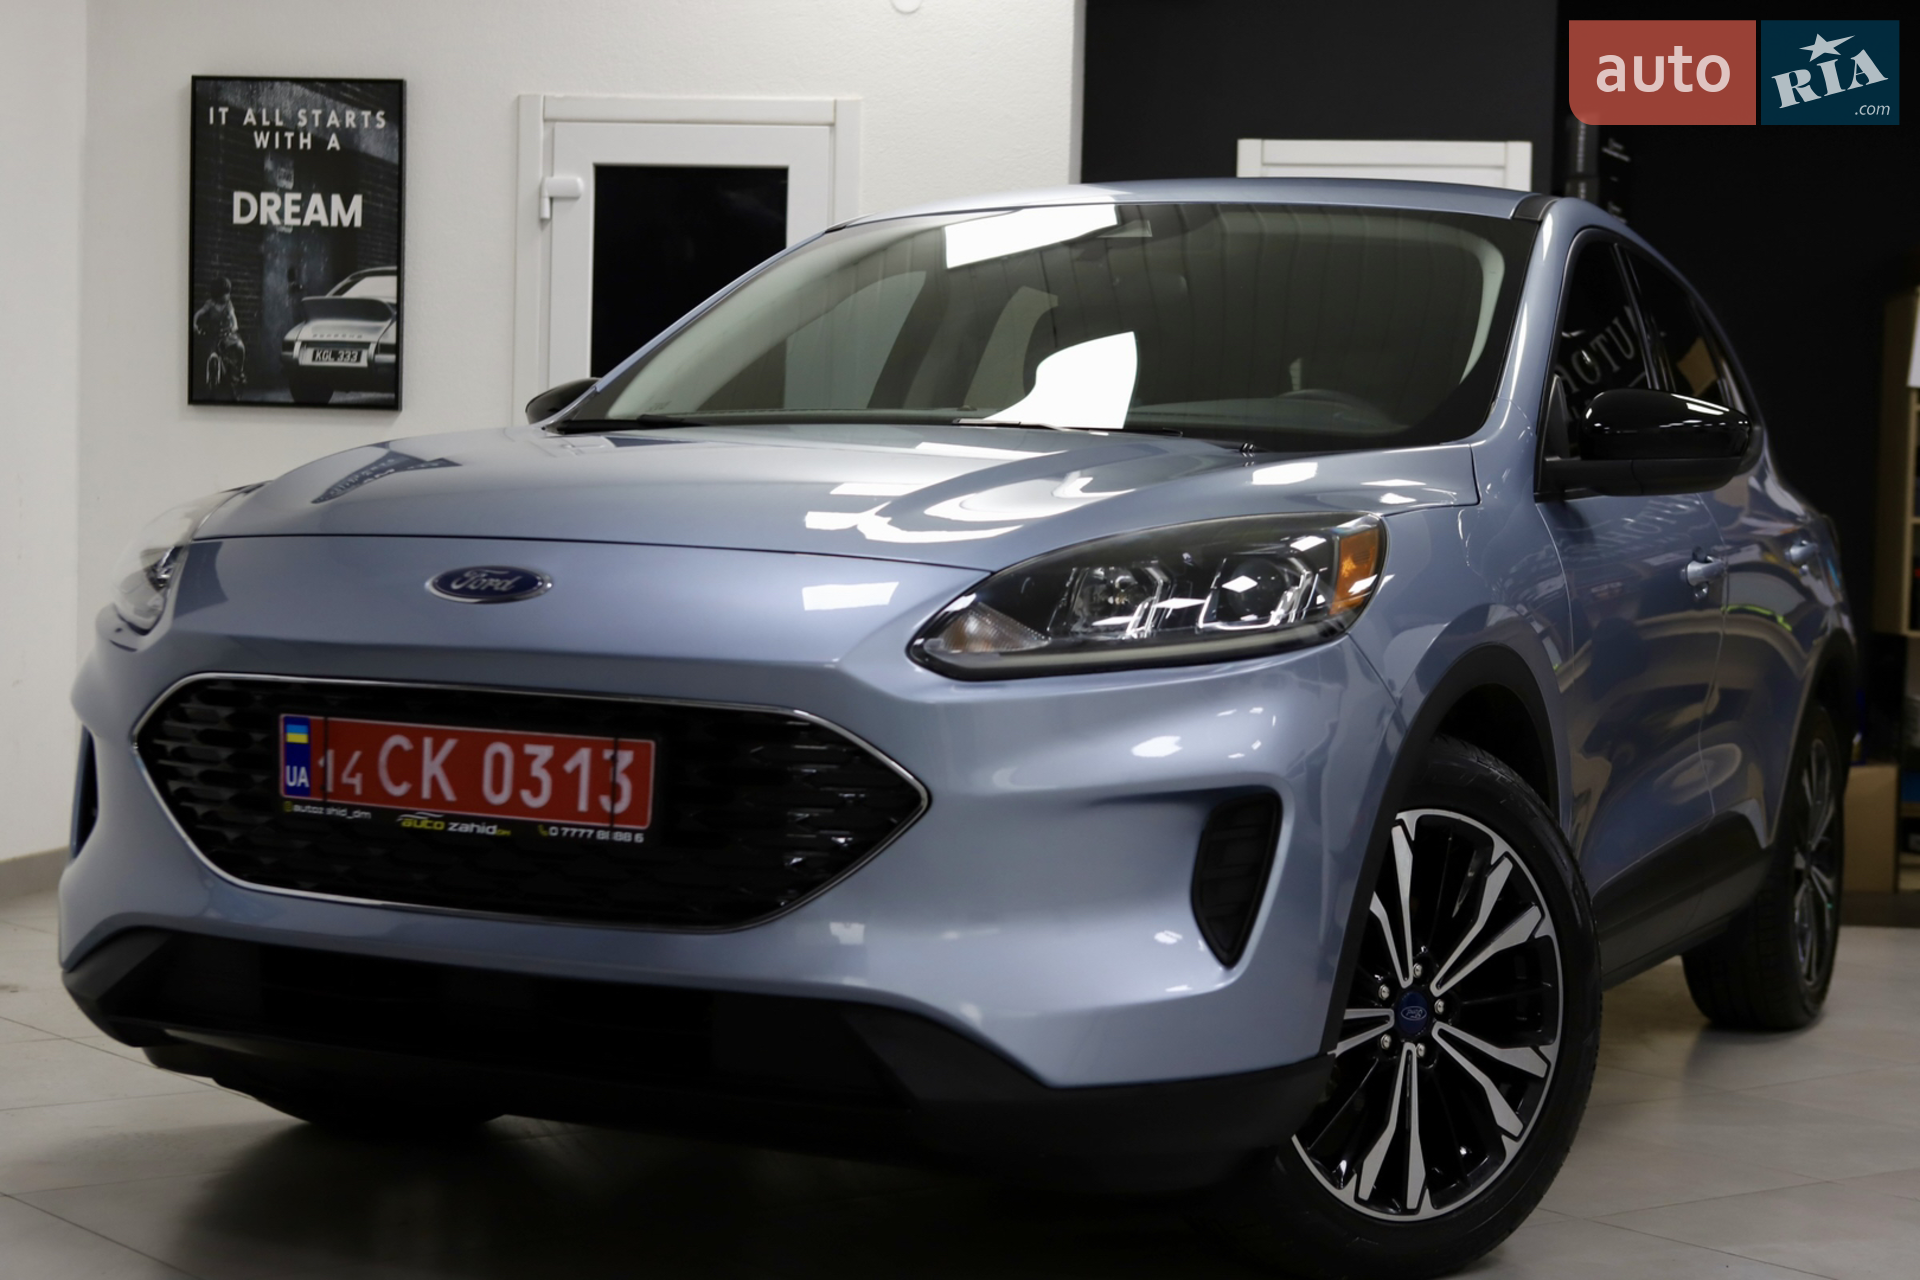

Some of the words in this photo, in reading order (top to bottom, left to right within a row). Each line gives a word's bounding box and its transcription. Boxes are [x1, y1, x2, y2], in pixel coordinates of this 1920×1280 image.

[208, 106, 230, 125] IT
[243, 107, 284, 127] ALL
[297, 108, 387, 129] STARTS
[253, 131, 313, 150] WITH
[326, 133, 341, 151] A
[232, 191, 363, 228] DREAM
[338, 349, 359, 362] 333
[450, 568, 523, 591] Ford
[285, 765, 310, 788] UA
[318, 749, 363, 796] 14
[377, 735, 459, 802] CK
[482, 741, 635, 815] 0313
[400, 818, 446, 831] auto
